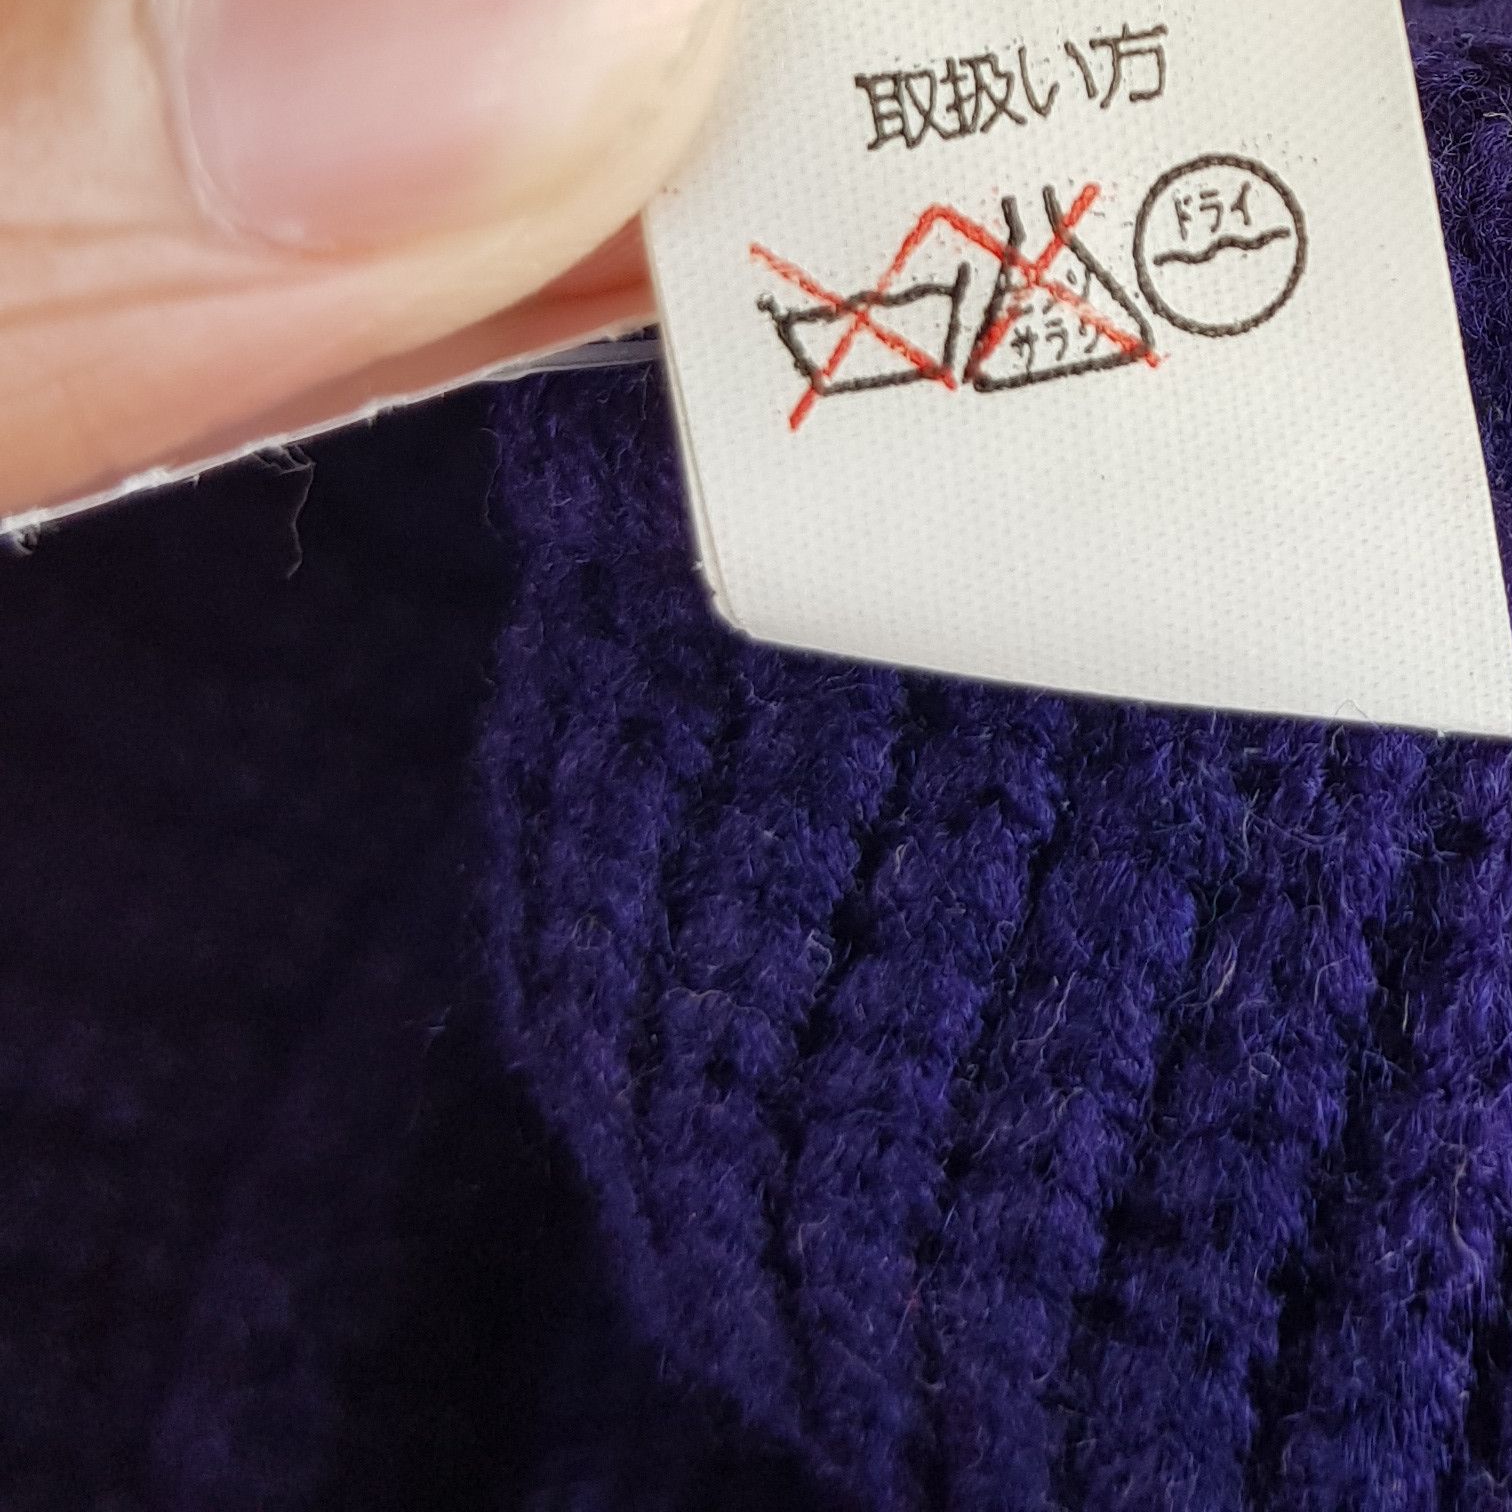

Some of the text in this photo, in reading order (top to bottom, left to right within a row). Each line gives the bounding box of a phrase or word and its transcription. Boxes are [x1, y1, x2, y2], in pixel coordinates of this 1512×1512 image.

[854, 22, 1169, 151] 取扱い方
[1173, 180, 1252, 241] ドライ
